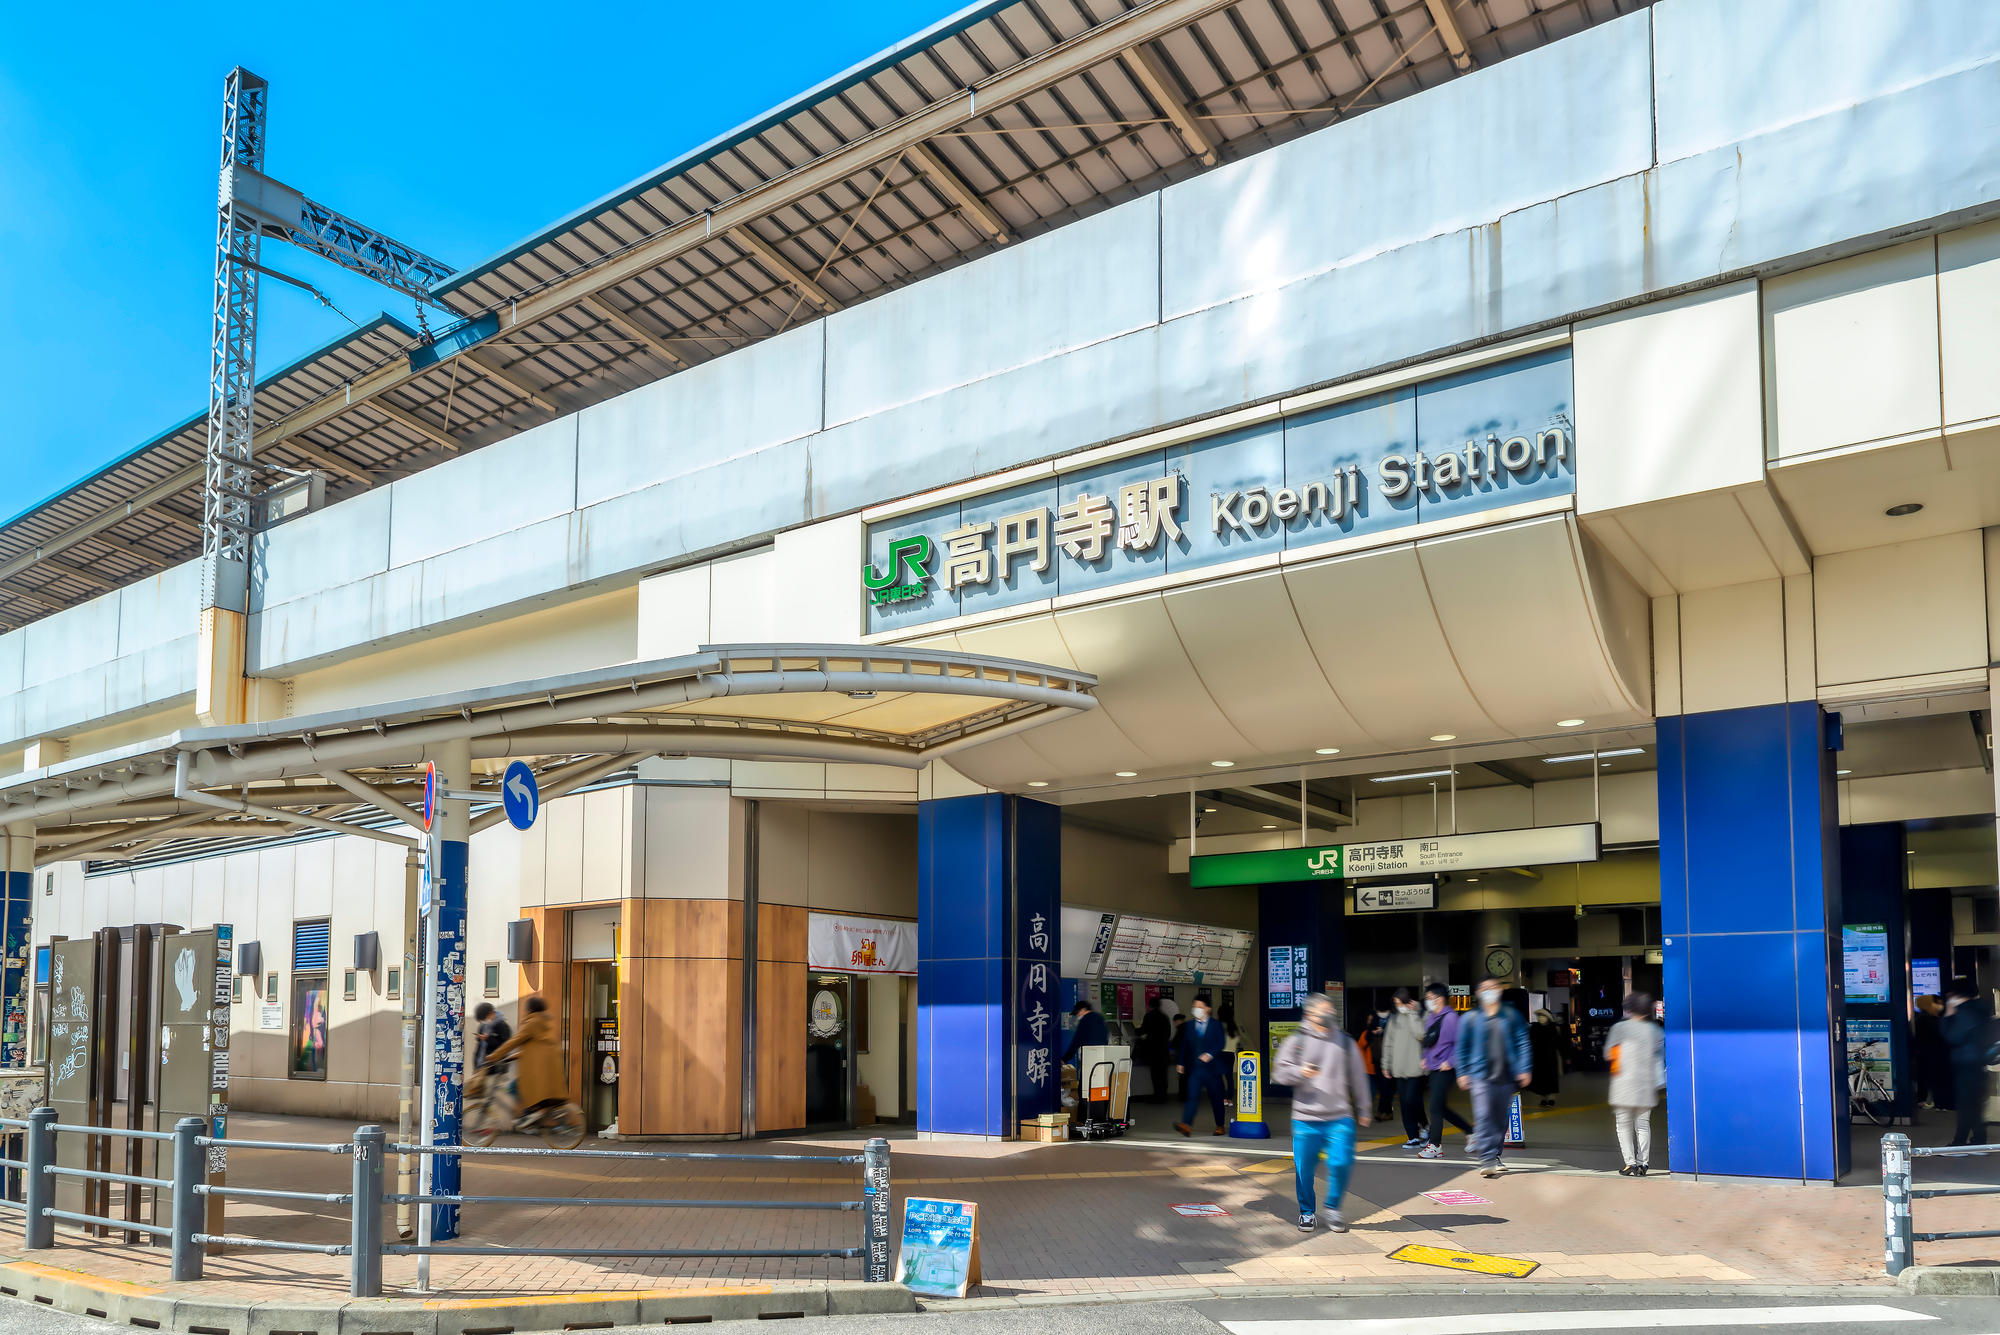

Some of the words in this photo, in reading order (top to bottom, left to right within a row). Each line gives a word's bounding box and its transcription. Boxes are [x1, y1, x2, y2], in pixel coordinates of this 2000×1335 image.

[1210, 464, 1359, 535] Kōenji
[1378, 422, 1567, 498] Station
[940, 474, 1184, 592] 高円寺駅
[864, 533, 934, 591] JR
[870, 582, 926, 606] JR東日本
[1349, 845, 1404, 862] 高円寺駅
[1420, 842, 1438, 852] 南口
[1438, 850, 1463, 858] Entrance
[1308, 849, 1338, 870] JR
[1378, 861, 1408, 870] Station
[1395, 887, 1430, 896] きっぷうりば
[861, 938, 876, 950] 幻の
[851, 950, 886, 966] 卵屋さん
[214, 965, 231, 1005] RULER
[212, 1051, 229, 1091] RULER
